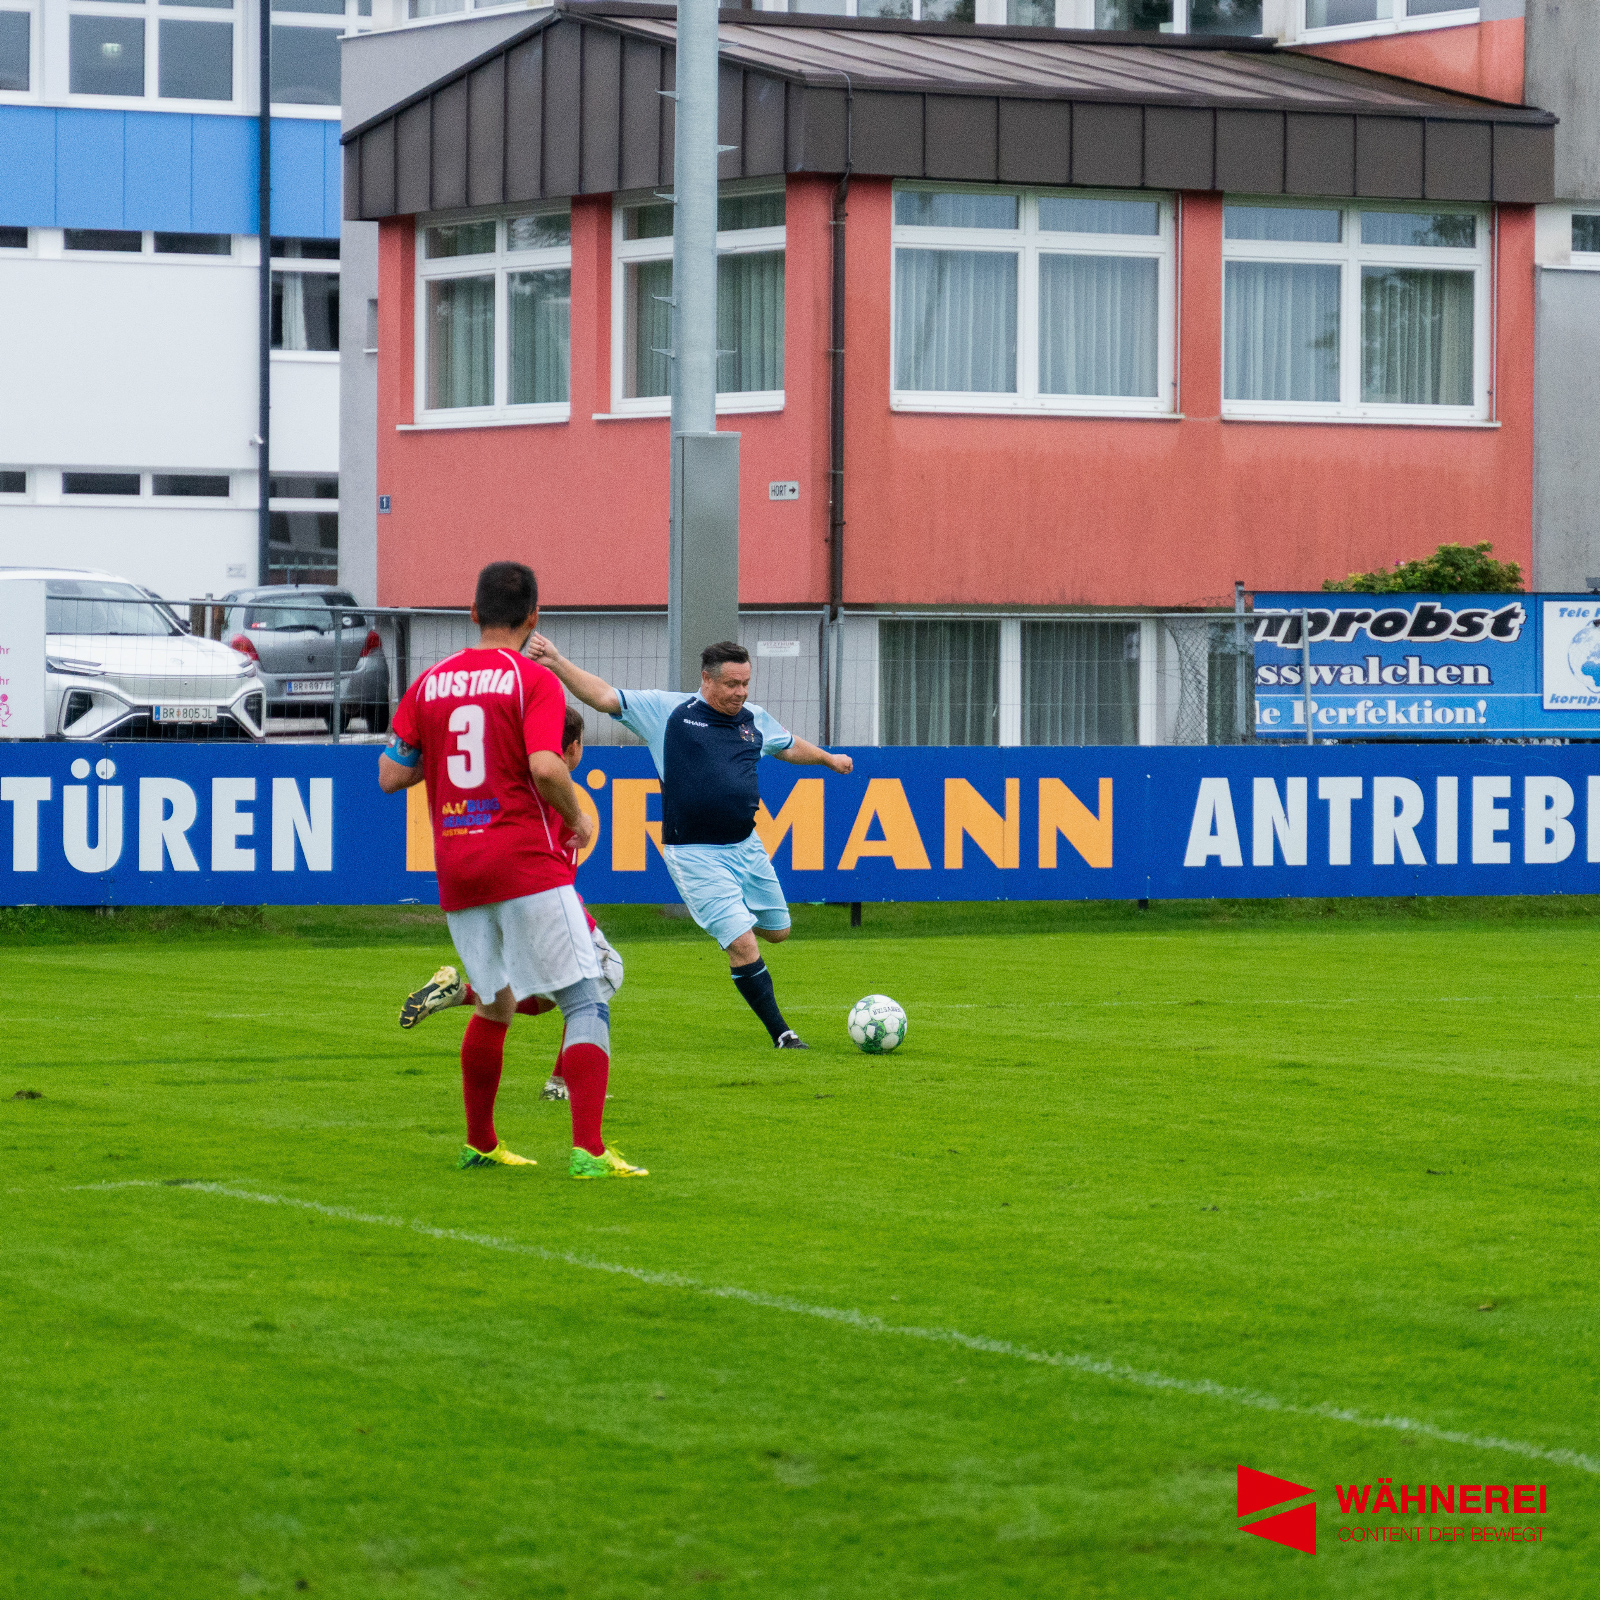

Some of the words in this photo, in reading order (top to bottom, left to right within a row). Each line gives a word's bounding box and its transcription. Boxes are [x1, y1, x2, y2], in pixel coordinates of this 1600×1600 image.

[771, 485, 787, 496] HORT
[1559, 607, 1590, 617] Tele
[1255, 655, 1494, 686] sswalchen
[424, 668, 515, 702] AUSTRIA
[1549, 693, 1600, 706] kornp
[162, 708, 175, 718] BR
[1291, 700, 1487, 725] Perfektion!
[447, 704, 486, 789] 3
[1, 758, 333, 873] TÜREN
